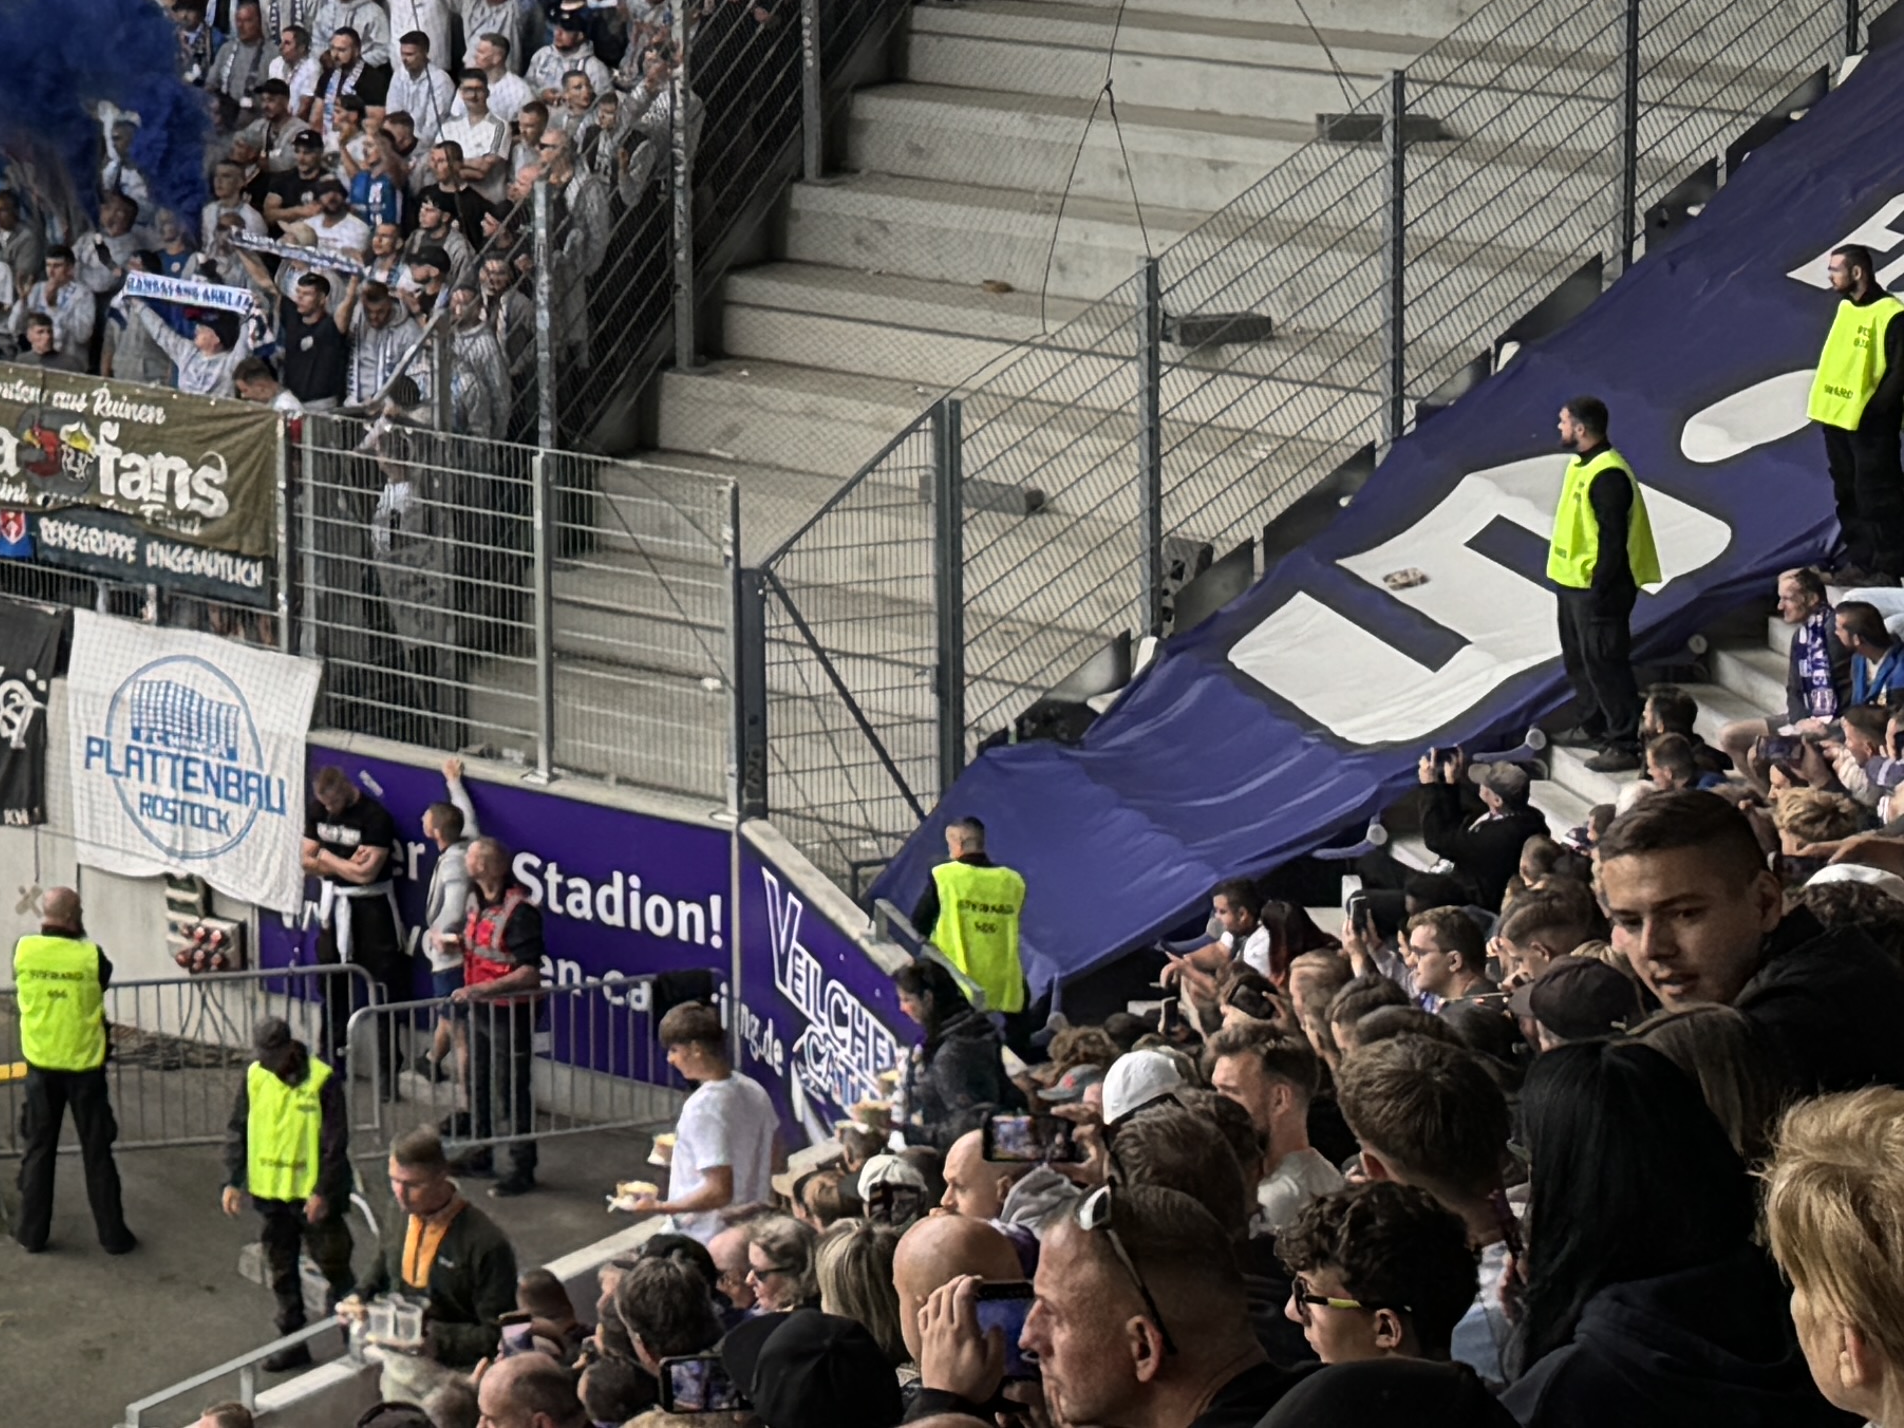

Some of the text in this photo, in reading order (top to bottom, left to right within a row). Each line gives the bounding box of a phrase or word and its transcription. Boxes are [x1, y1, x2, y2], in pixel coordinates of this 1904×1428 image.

[92, 387, 166, 425] Ruinen
[88, 421, 230, 518] fans
[84, 735, 287, 816] PLATTENBAU
[139, 791, 232, 837] ROSTOCK
[511, 851, 723, 949] Stadion!
